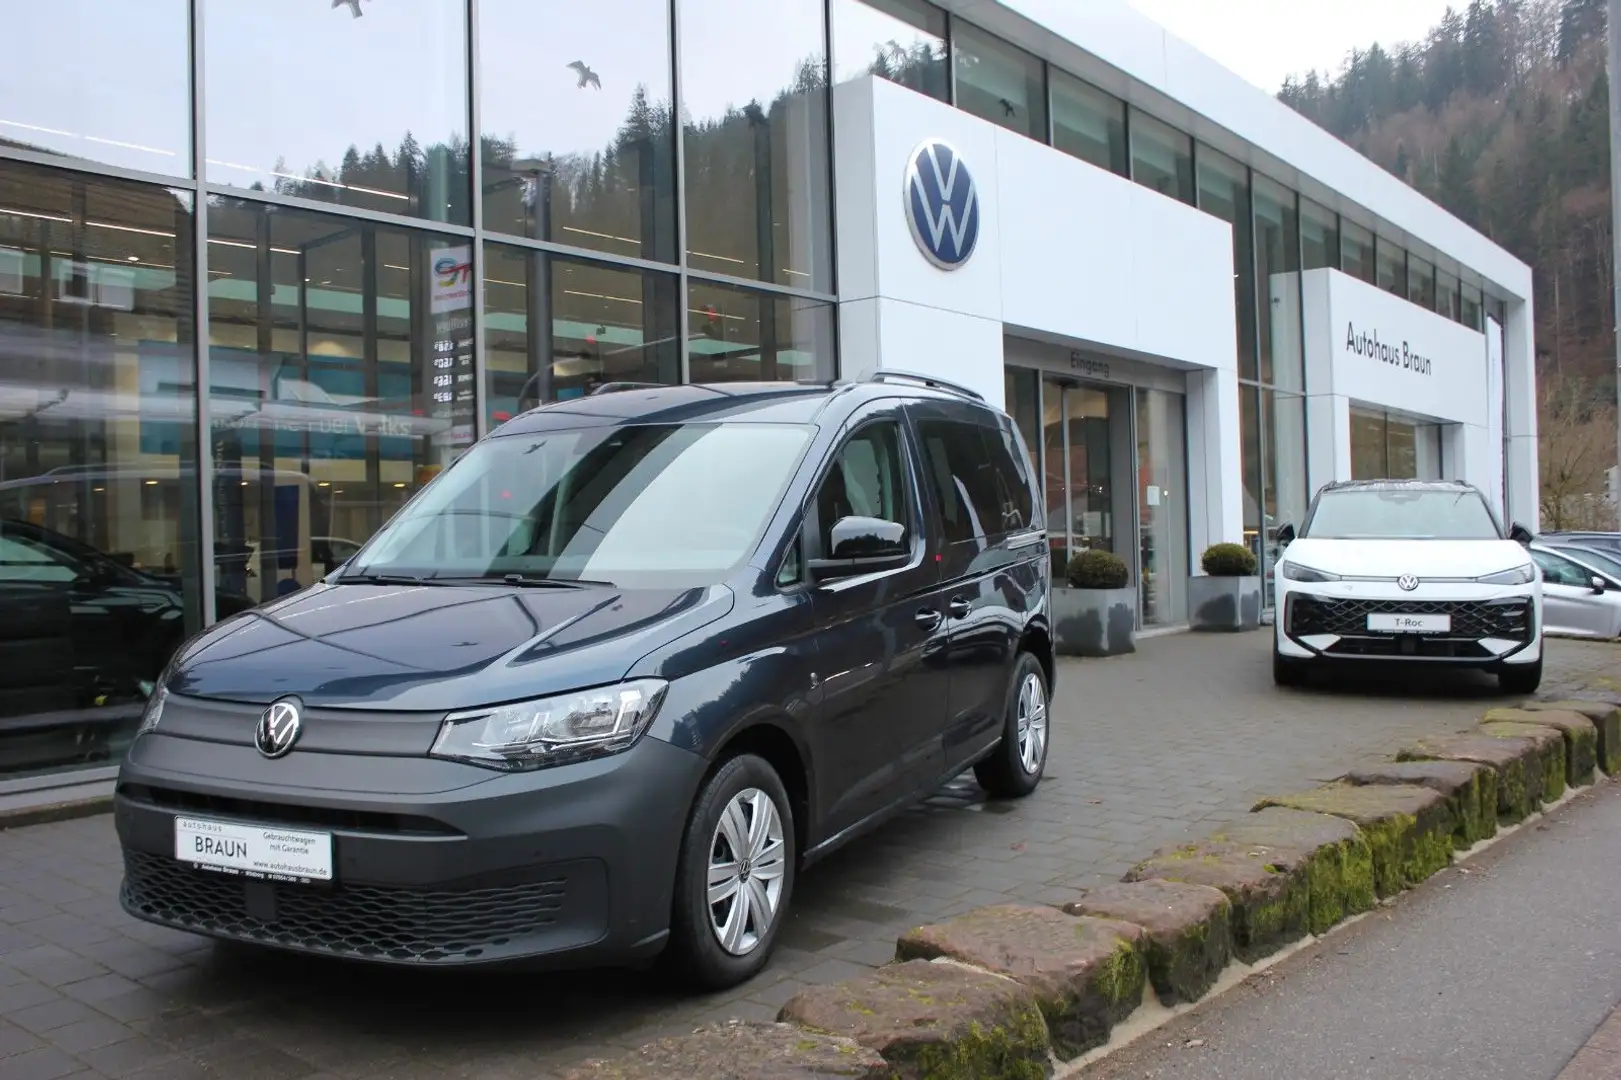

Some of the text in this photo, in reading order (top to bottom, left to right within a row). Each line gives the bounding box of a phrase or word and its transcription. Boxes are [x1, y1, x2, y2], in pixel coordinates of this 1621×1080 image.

[1346, 320, 1432, 376] Autohaus Braun
[1070, 350, 1110, 379] Eingang
[1394, 618, 1423, 627] T-Roc
[182, 820, 223, 832] autohaus
[262, 831, 316, 846] Gebrauchtwagen
[195, 835, 247, 858] BRAUN
[269, 843, 309, 855] mit Garantie
[253, 860, 327, 876] www.autohausbraun.de
